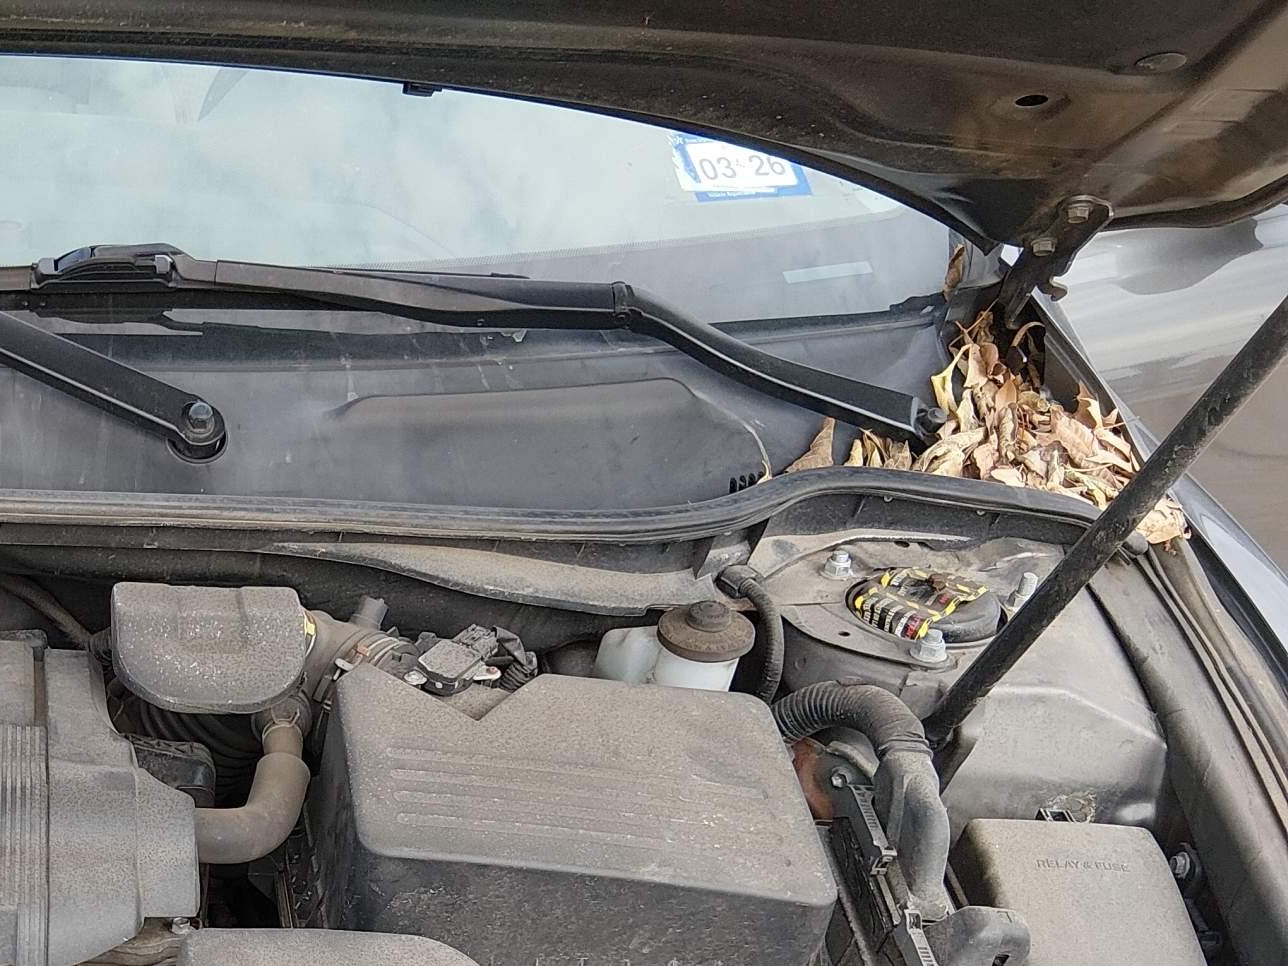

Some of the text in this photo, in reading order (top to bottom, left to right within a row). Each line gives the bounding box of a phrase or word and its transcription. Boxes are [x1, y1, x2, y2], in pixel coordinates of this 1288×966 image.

[699, 157, 737, 181] 03
[1035, 858, 1080, 870] RELAY
[1093, 861, 1131, 873] FUSE
